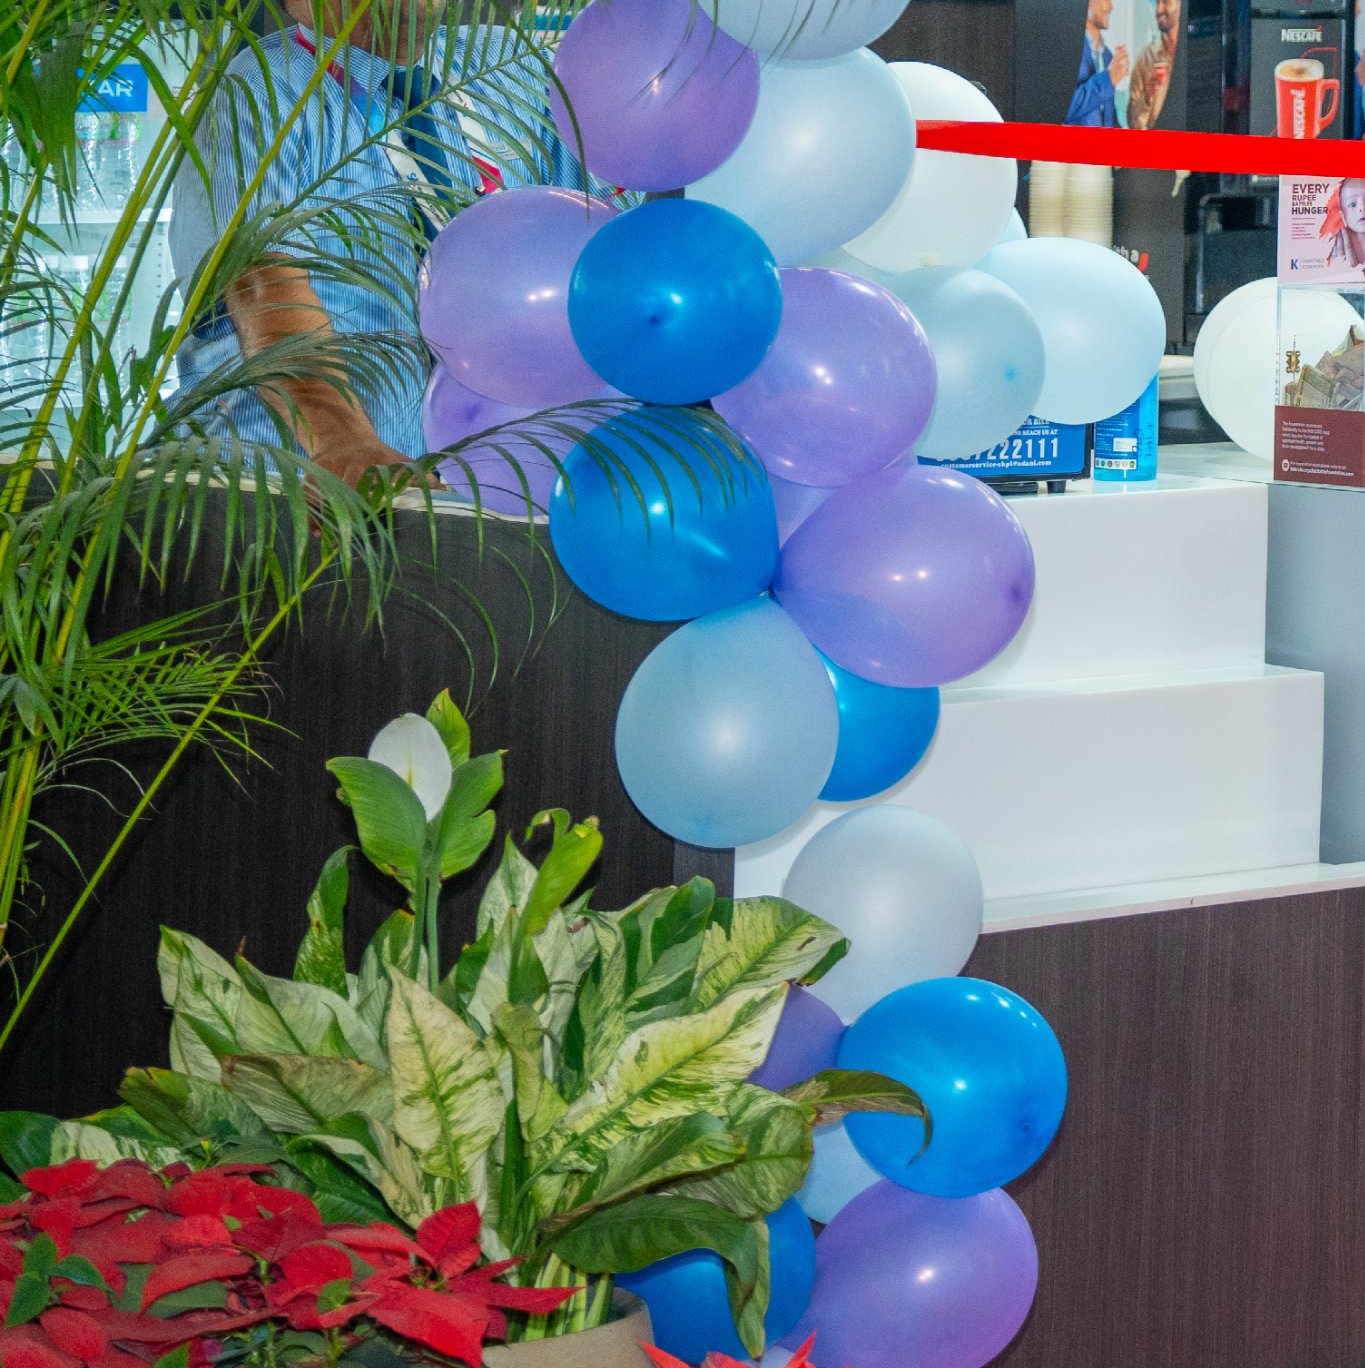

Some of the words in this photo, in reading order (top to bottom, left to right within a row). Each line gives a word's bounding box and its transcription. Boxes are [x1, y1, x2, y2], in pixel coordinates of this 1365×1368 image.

[1292, 183, 1330, 194] EVERY
[1291, 194, 1317, 202] RUPEE
[1291, 206, 1329, 215] HUNGER
[1290, 258, 1299, 270] K
